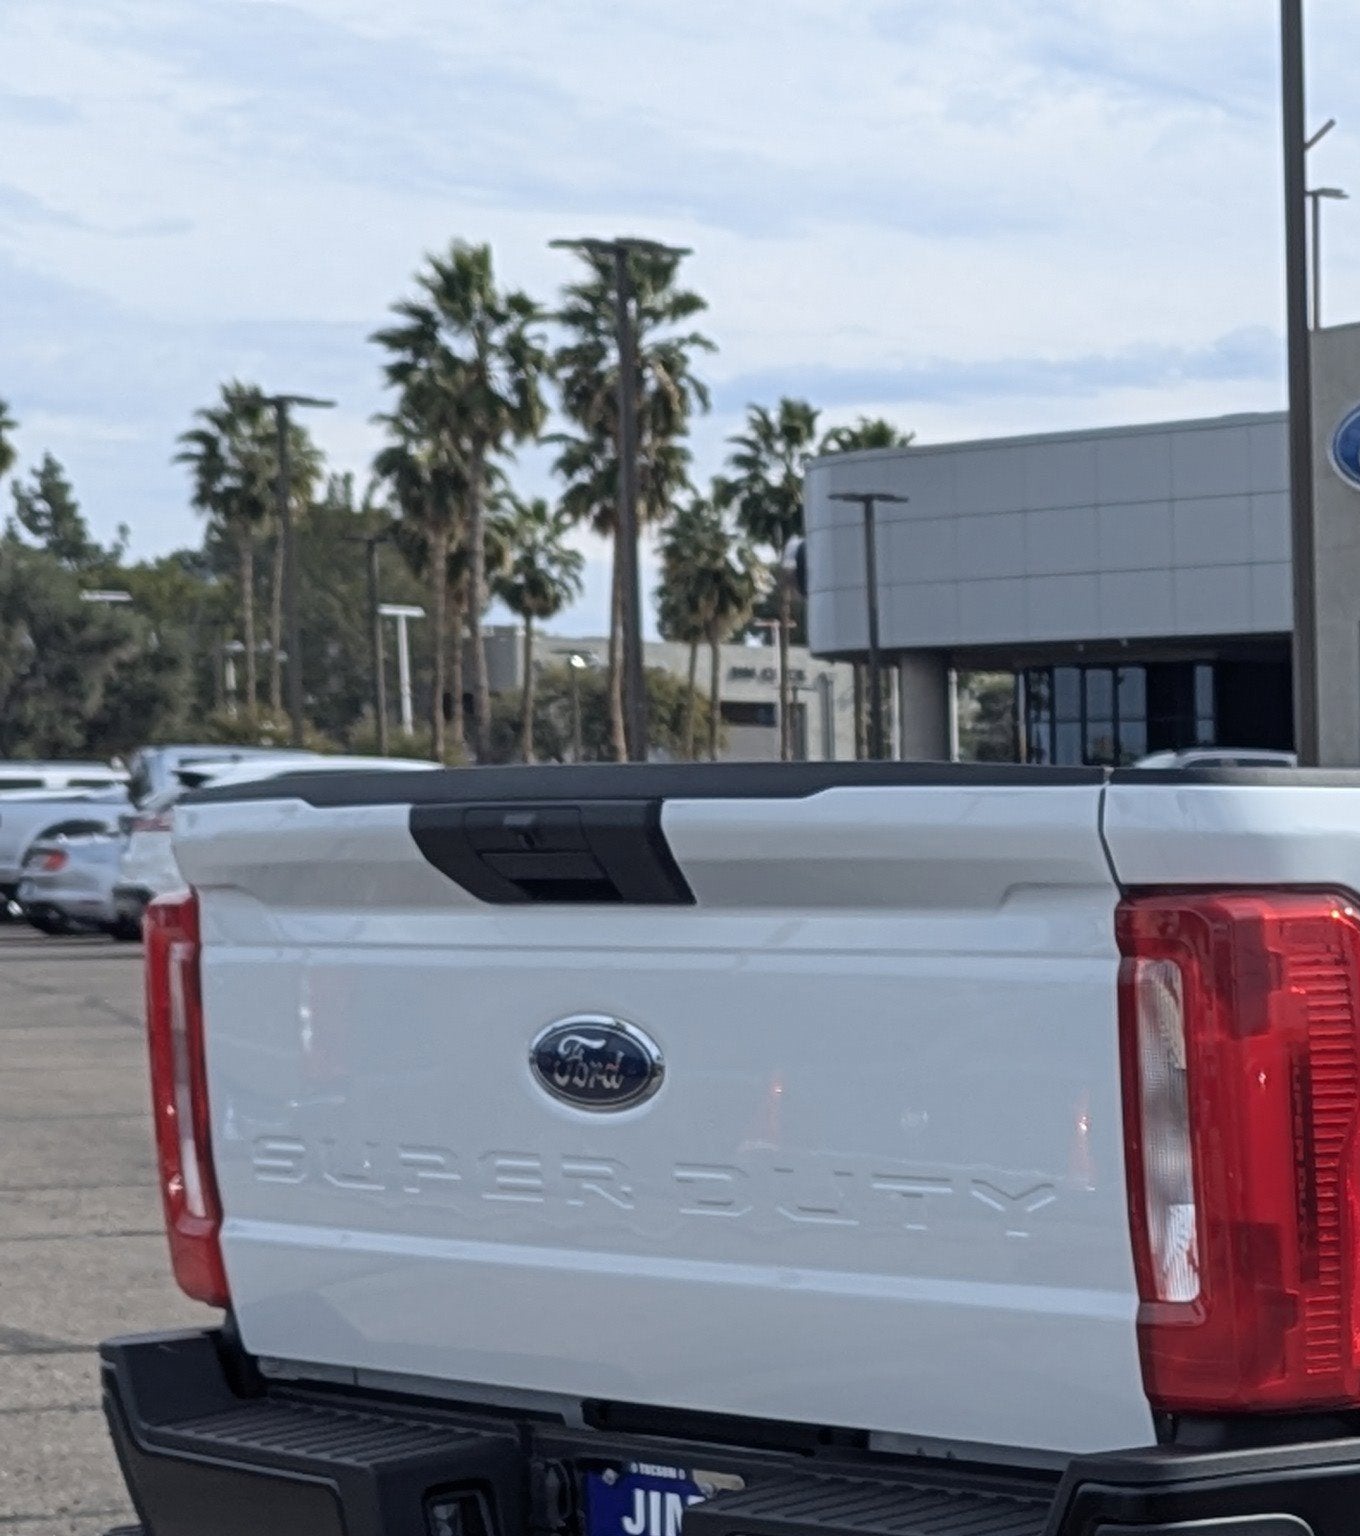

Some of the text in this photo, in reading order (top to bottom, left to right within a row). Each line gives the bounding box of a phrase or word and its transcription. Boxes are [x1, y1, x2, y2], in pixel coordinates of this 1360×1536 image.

[553, 1034, 626, 1090] Ford
[252, 1134, 1056, 1239] SUPER DUTY
